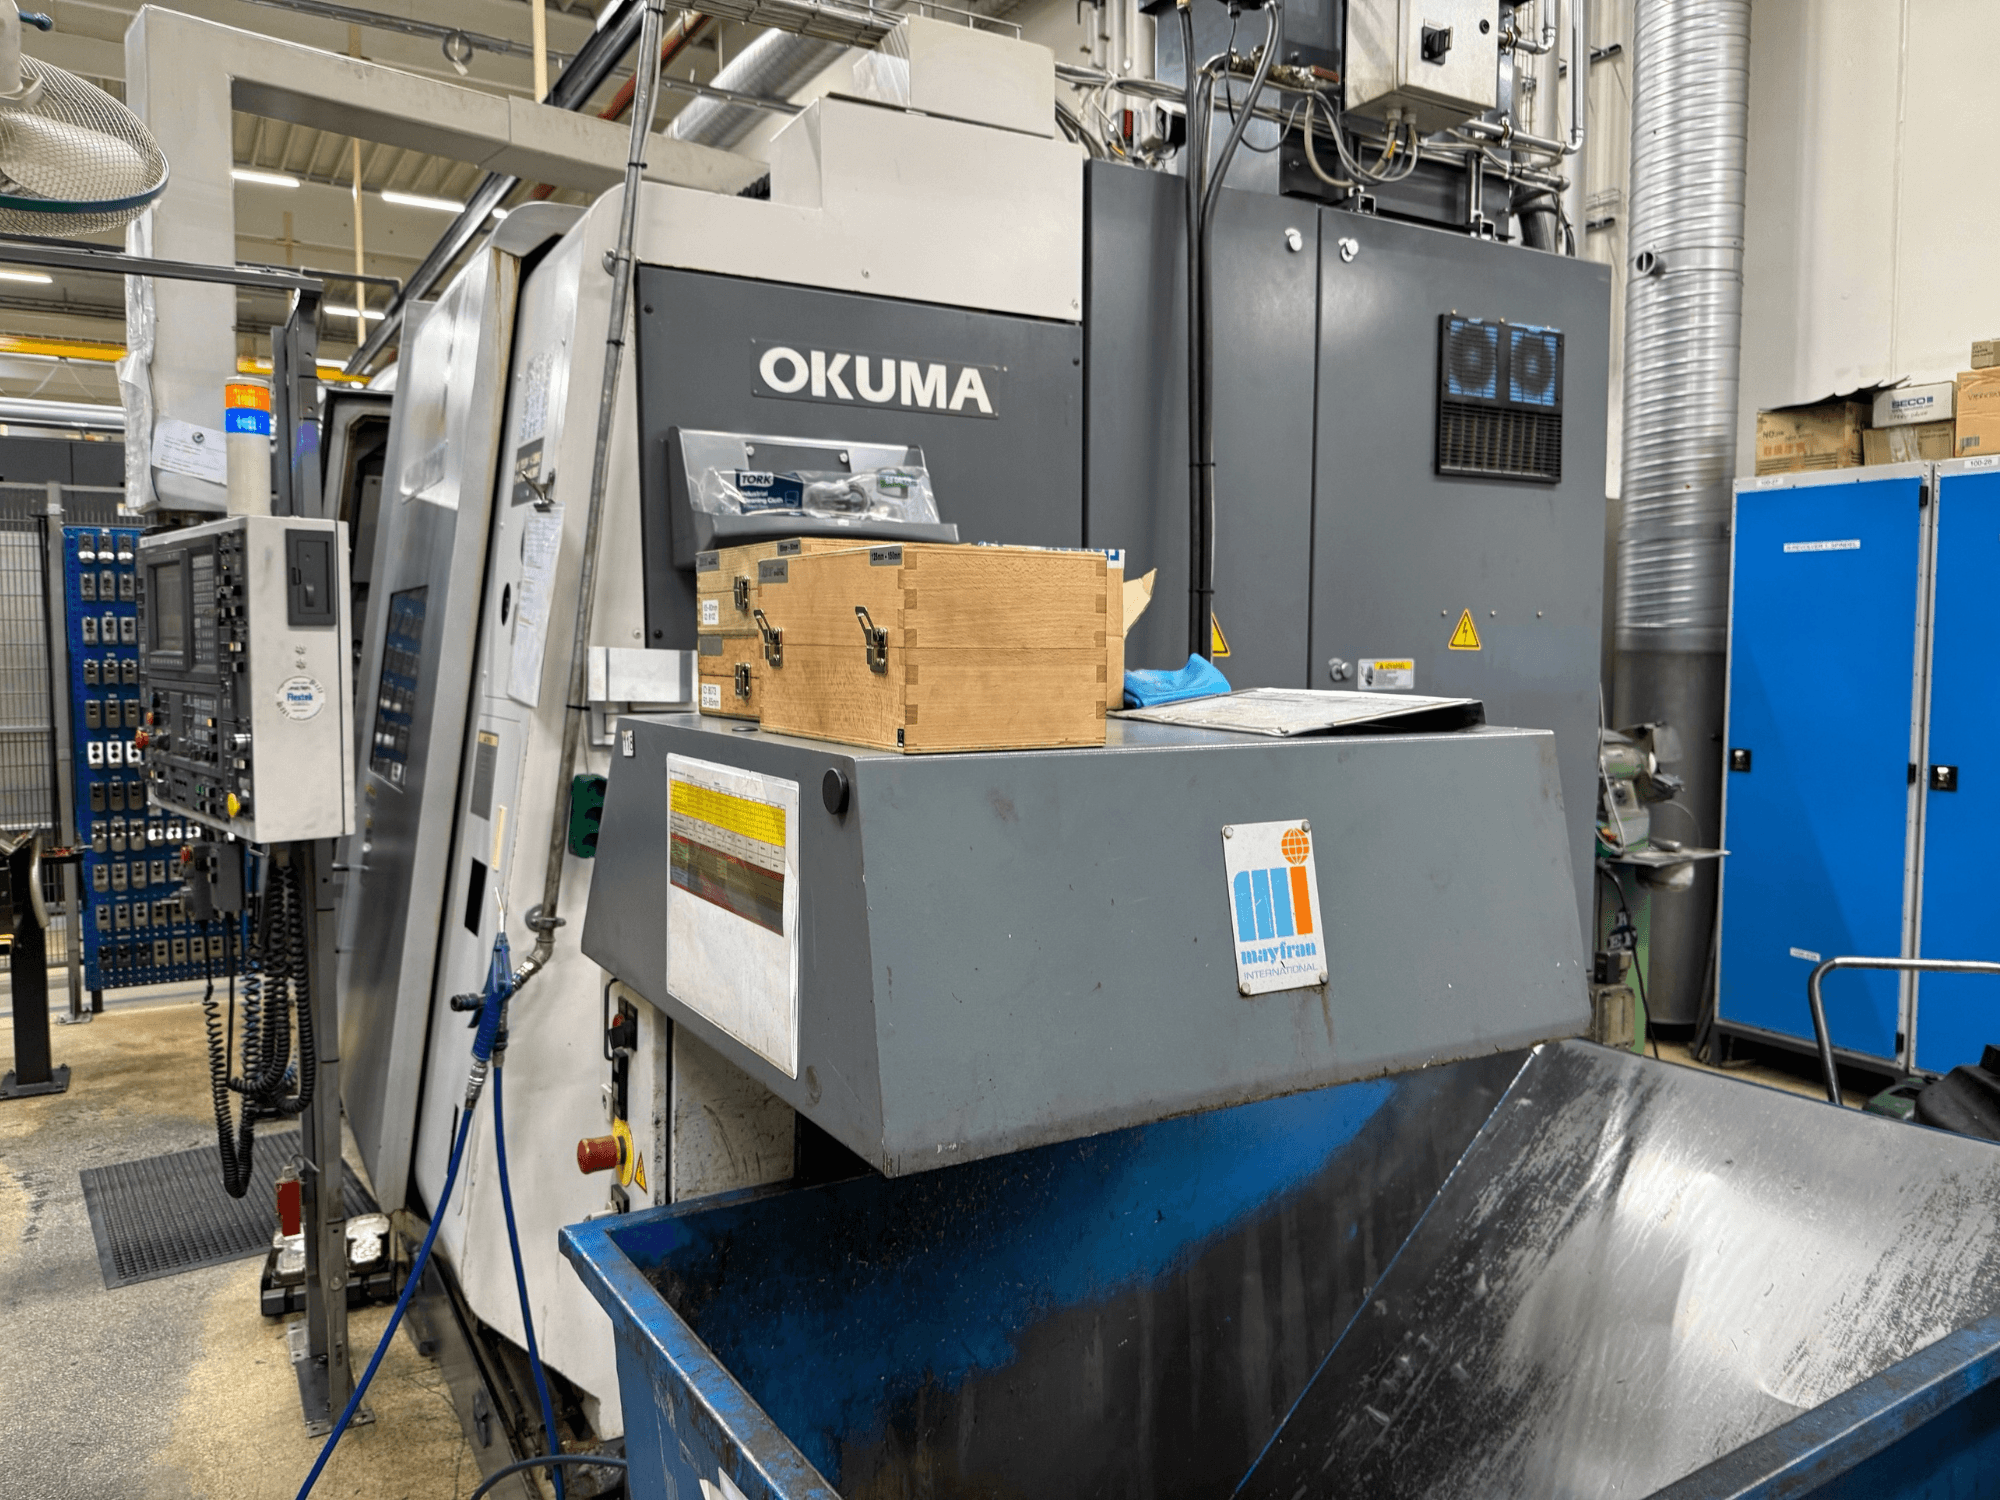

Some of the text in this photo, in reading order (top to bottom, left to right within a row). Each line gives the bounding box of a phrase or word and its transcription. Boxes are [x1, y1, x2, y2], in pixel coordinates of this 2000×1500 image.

[760, 347, 993, 413] OKUMA
[1891, 397, 1926, 409] SECO
[742, 474, 772, 485] TORK
[1240, 941, 1317, 965] mayfran
[1243, 962, 1318, 980] INTERNATIONAL
